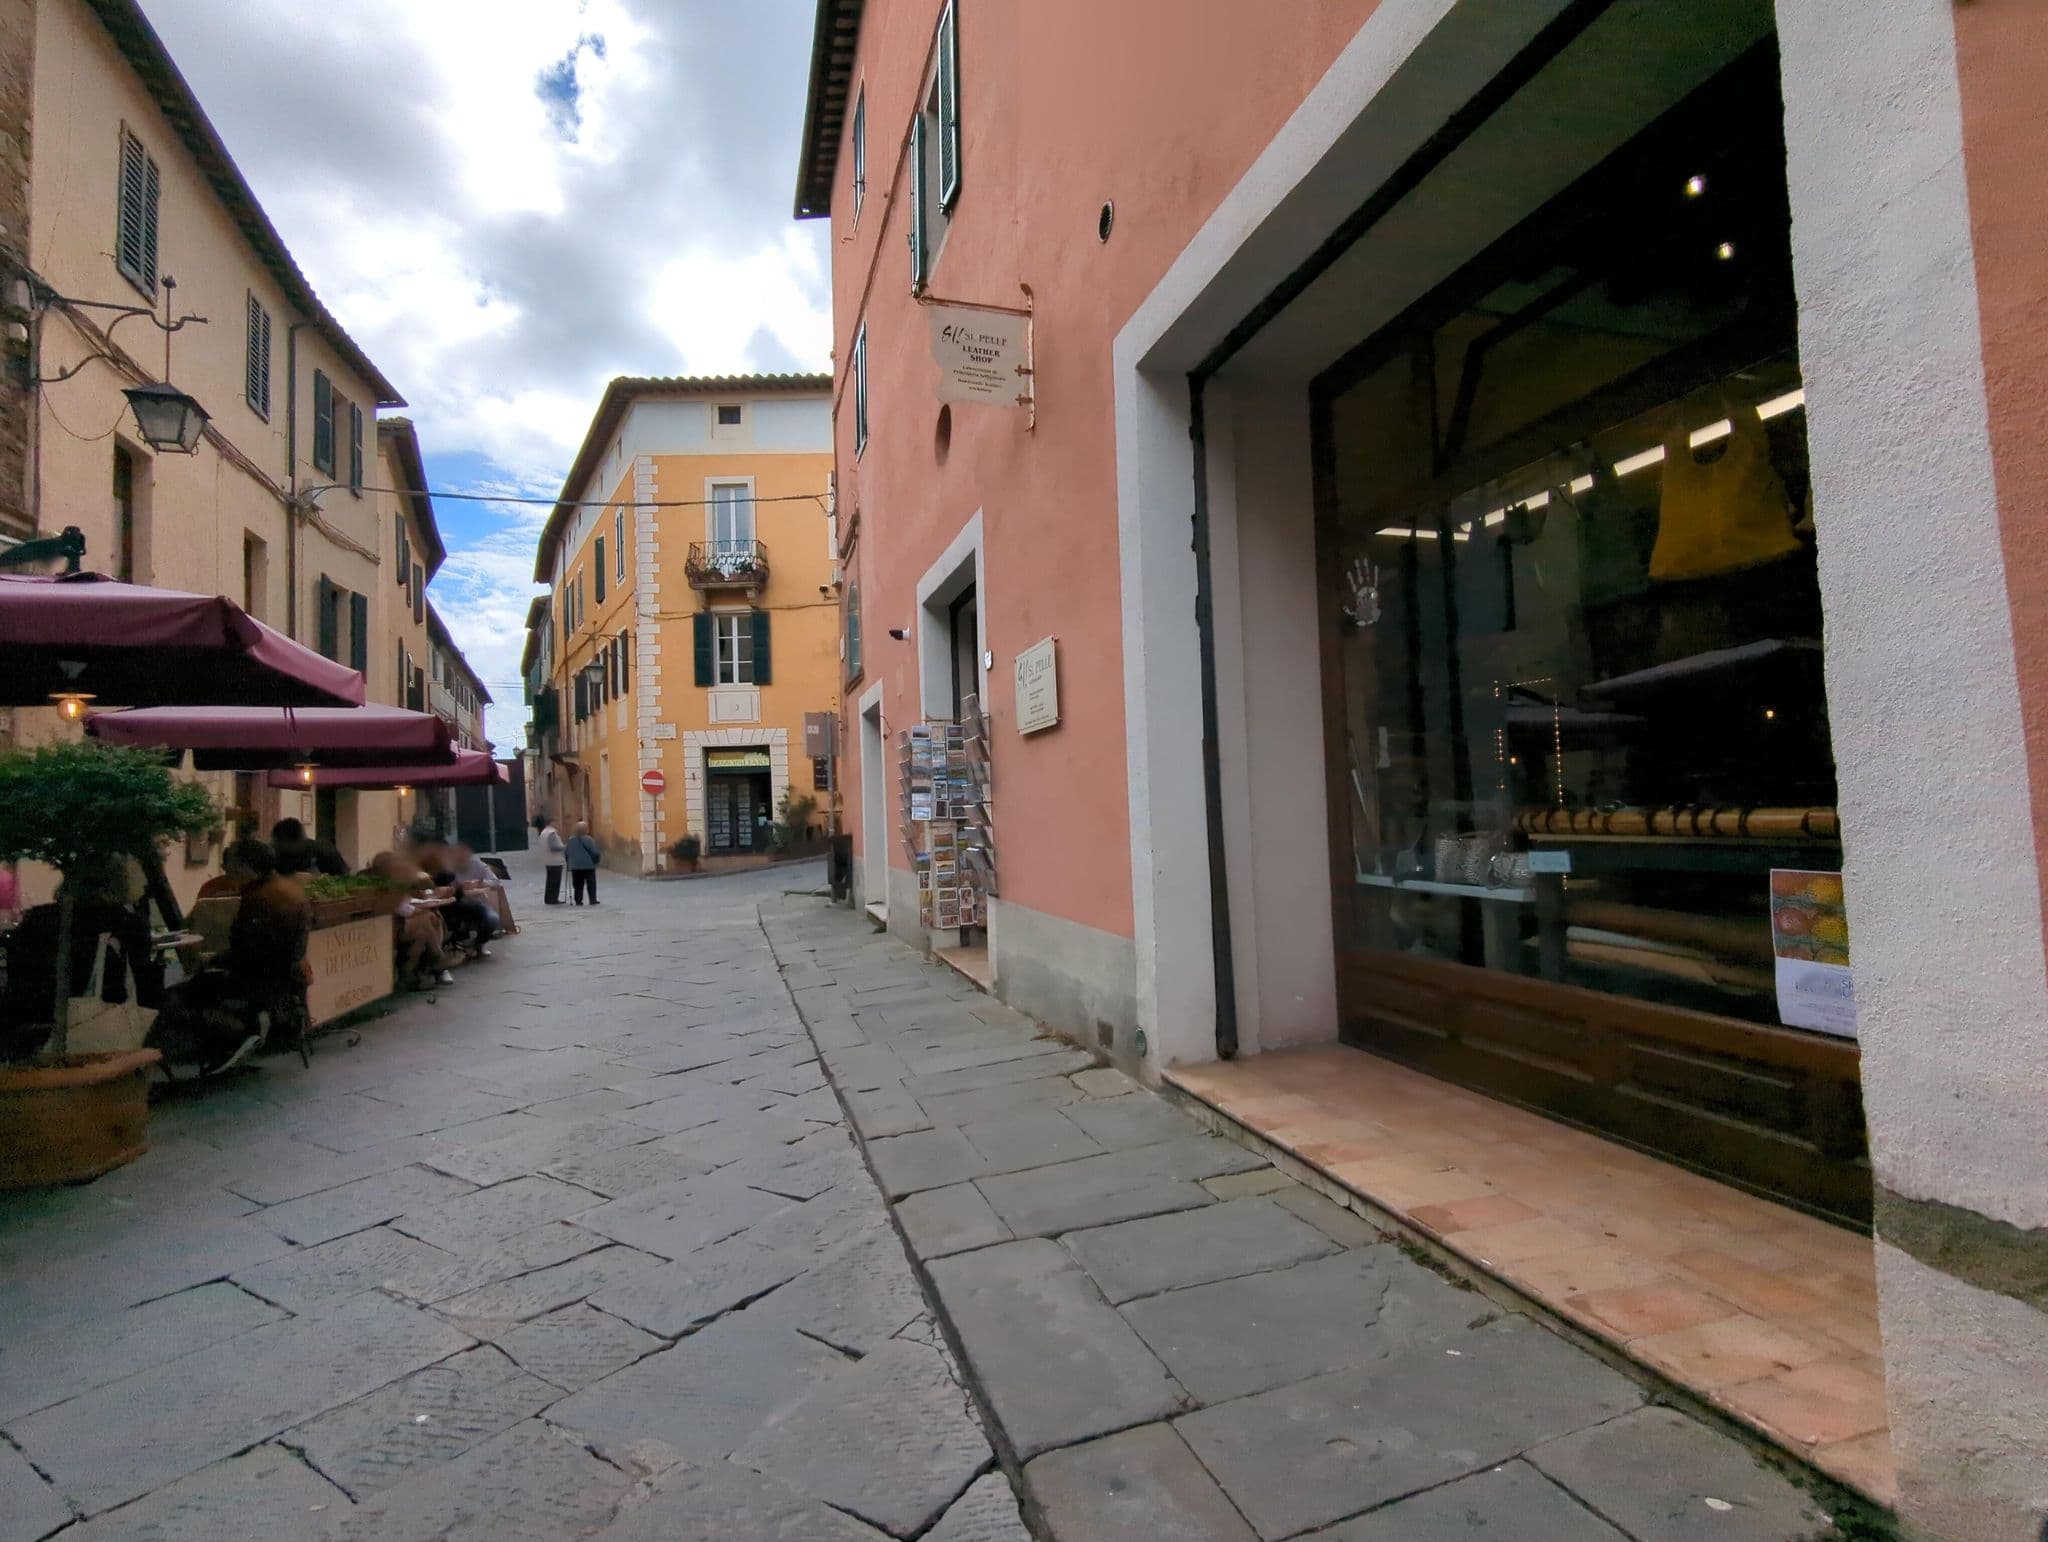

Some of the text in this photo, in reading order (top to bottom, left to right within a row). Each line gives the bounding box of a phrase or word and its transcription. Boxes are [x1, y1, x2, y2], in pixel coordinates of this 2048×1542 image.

[979, 334, 1007, 346] PELLE
[962, 345, 1000, 357] LEATHER
[970, 354, 993, 364] SHOP
